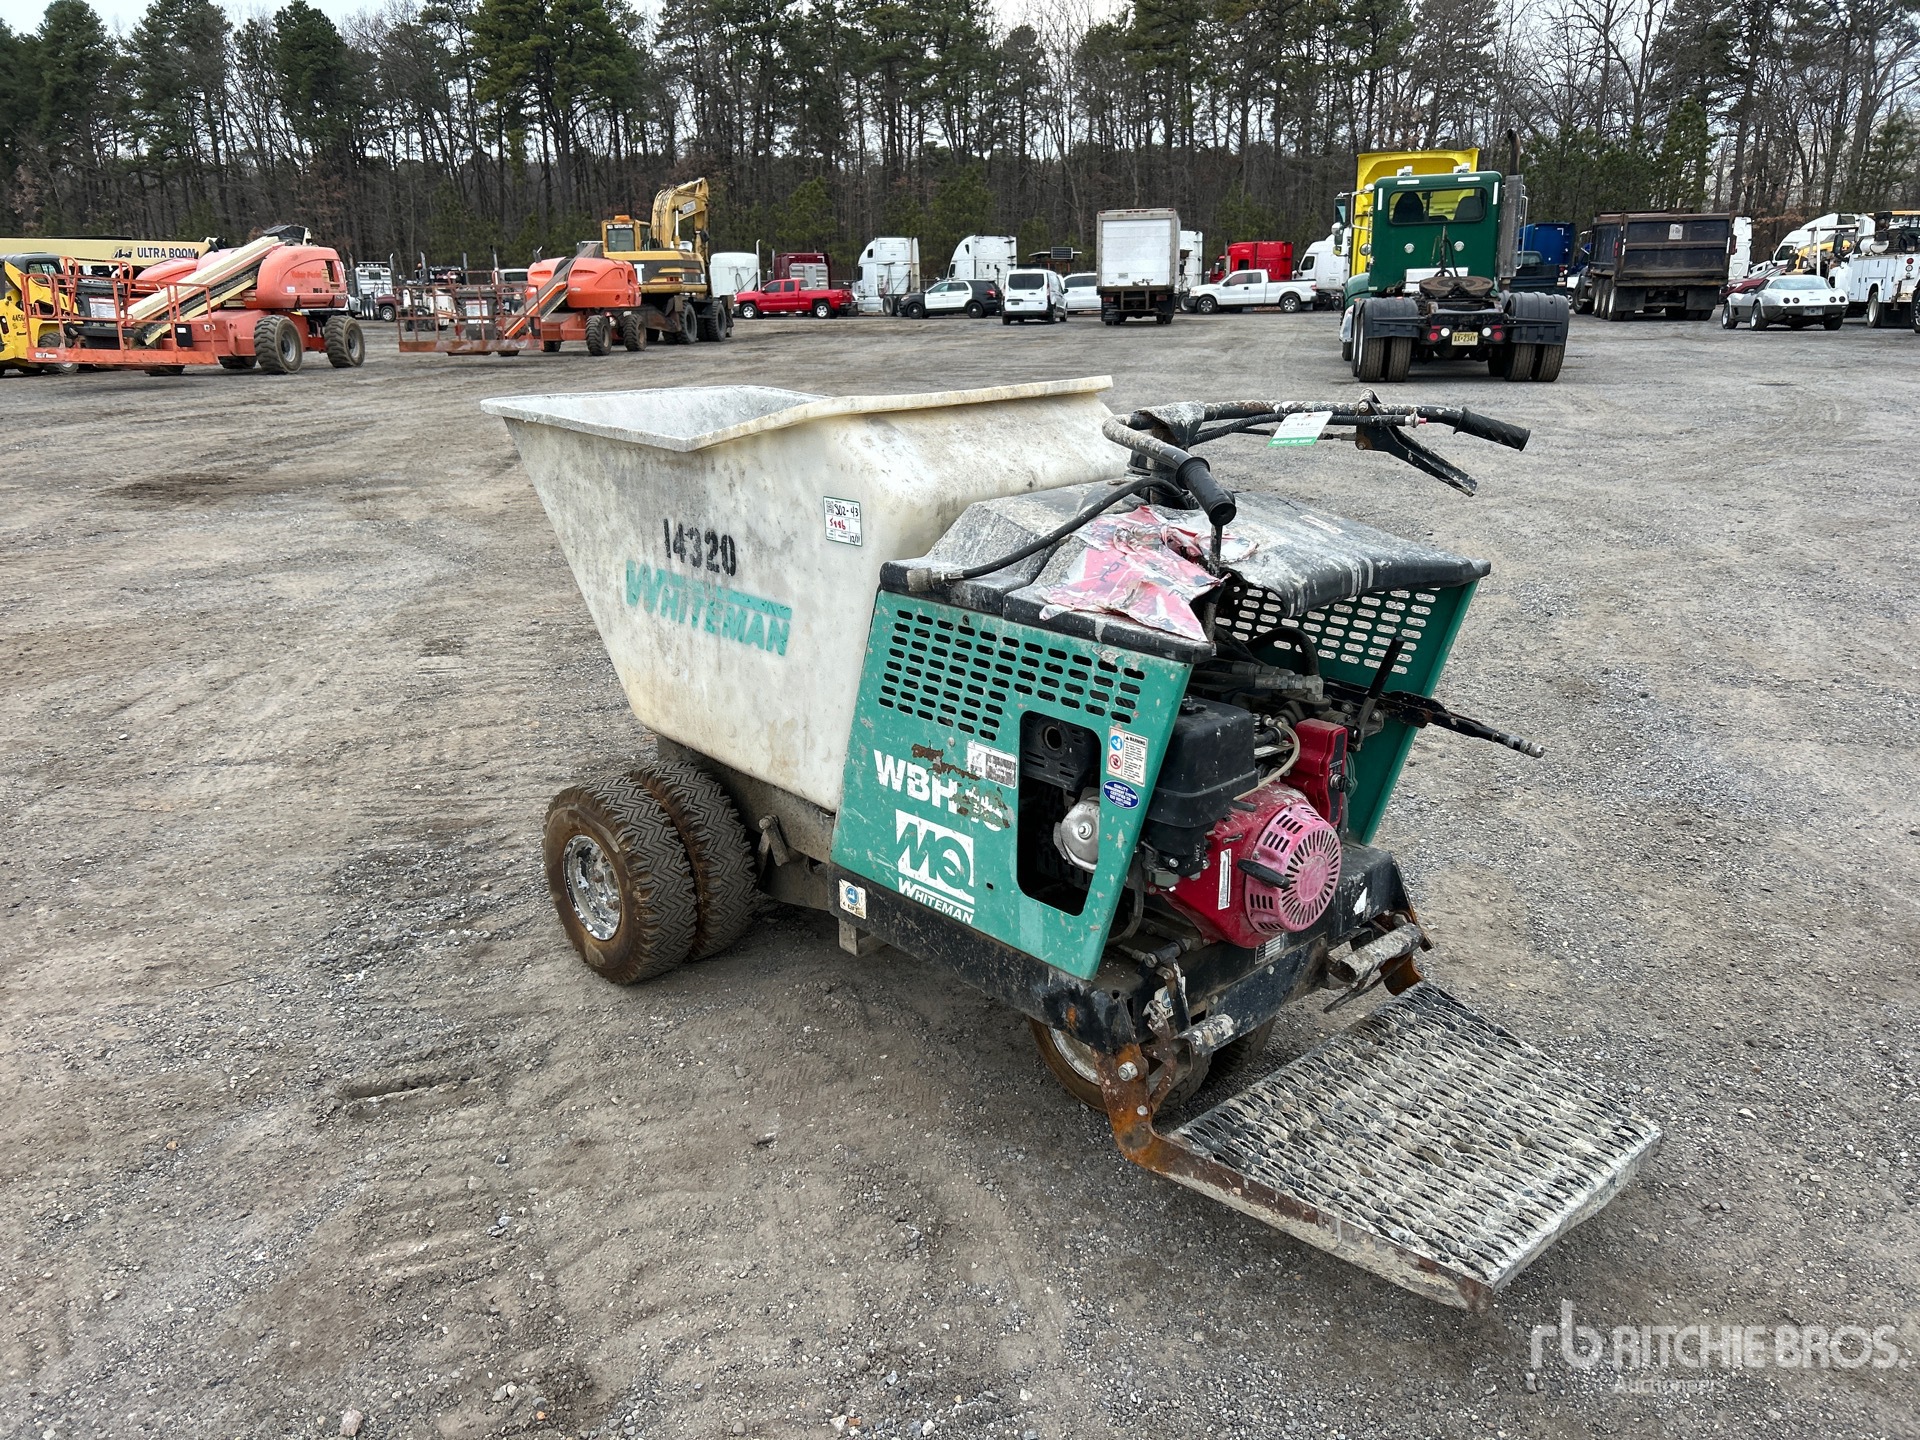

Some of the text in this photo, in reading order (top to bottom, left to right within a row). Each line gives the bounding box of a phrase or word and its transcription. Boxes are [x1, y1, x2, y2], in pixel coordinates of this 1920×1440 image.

[137, 247, 166, 258] ULTRA
[168, 247, 197, 259] BOOM
[663, 518, 737, 577] 14320
[625, 559, 792, 656] WHITEMAN
[898, 876, 975, 925] WHITEMAN
